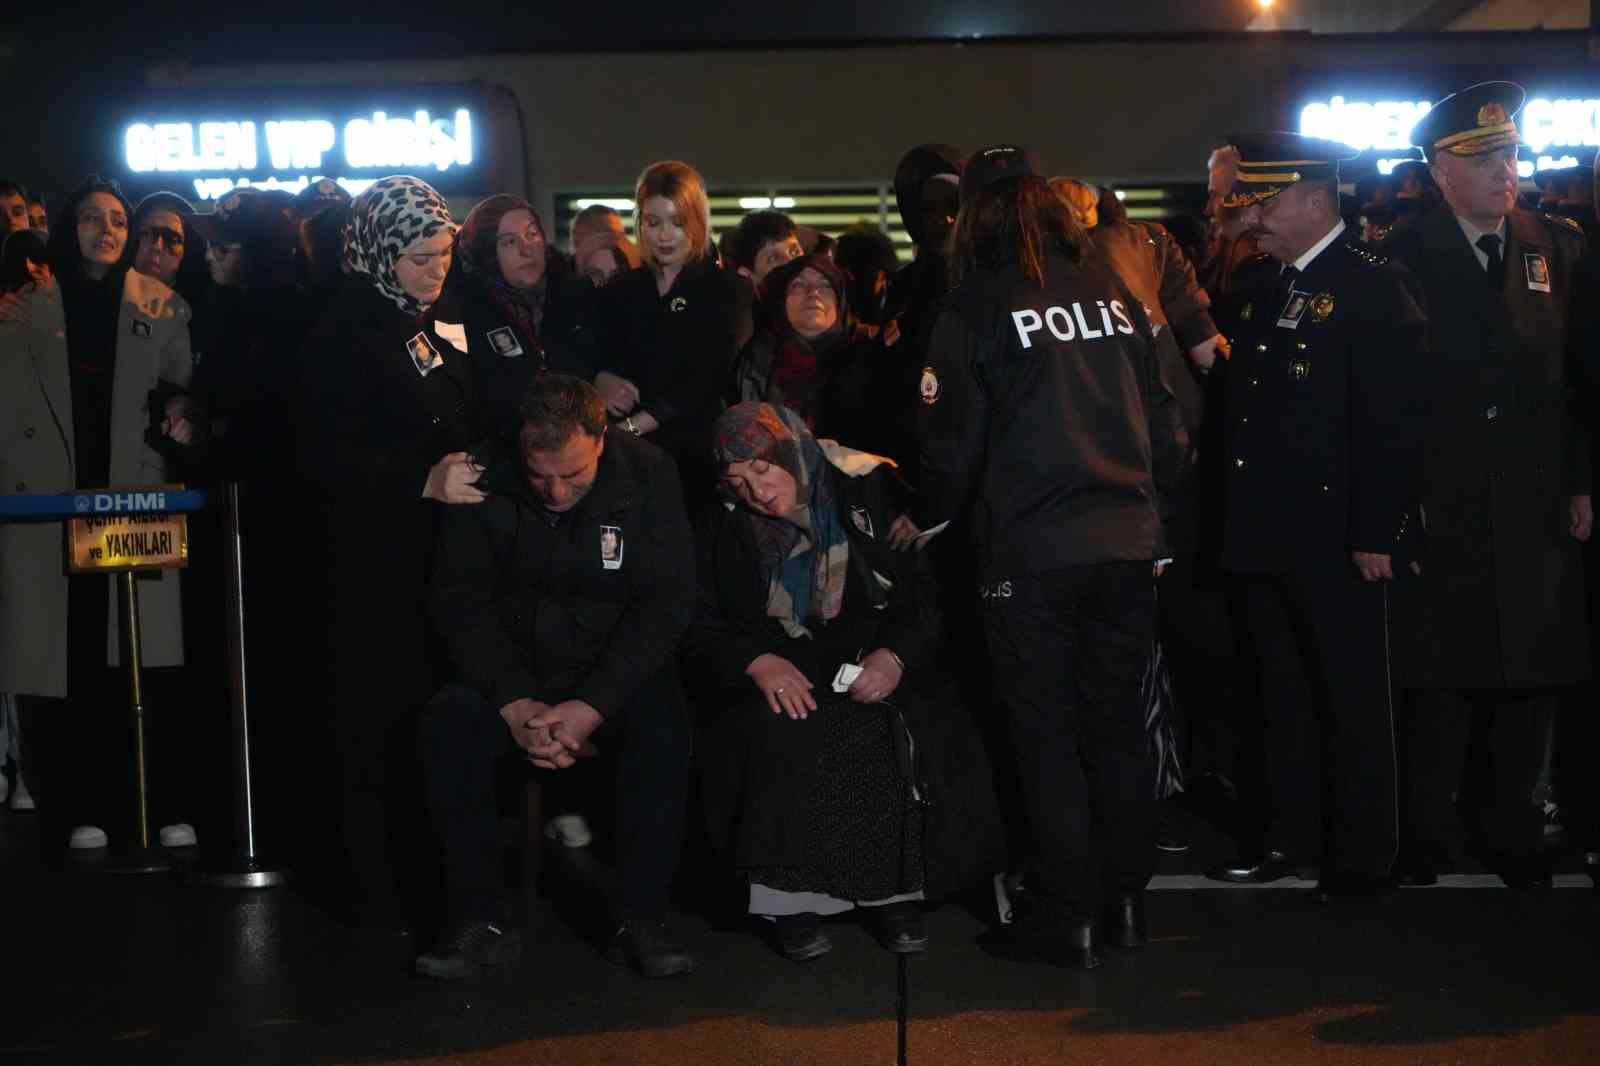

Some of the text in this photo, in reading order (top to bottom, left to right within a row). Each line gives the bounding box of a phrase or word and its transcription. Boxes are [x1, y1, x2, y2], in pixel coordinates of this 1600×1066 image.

[126, 121, 257, 171] GELEN
[88, 531, 173, 559] ve YAKINLARI
